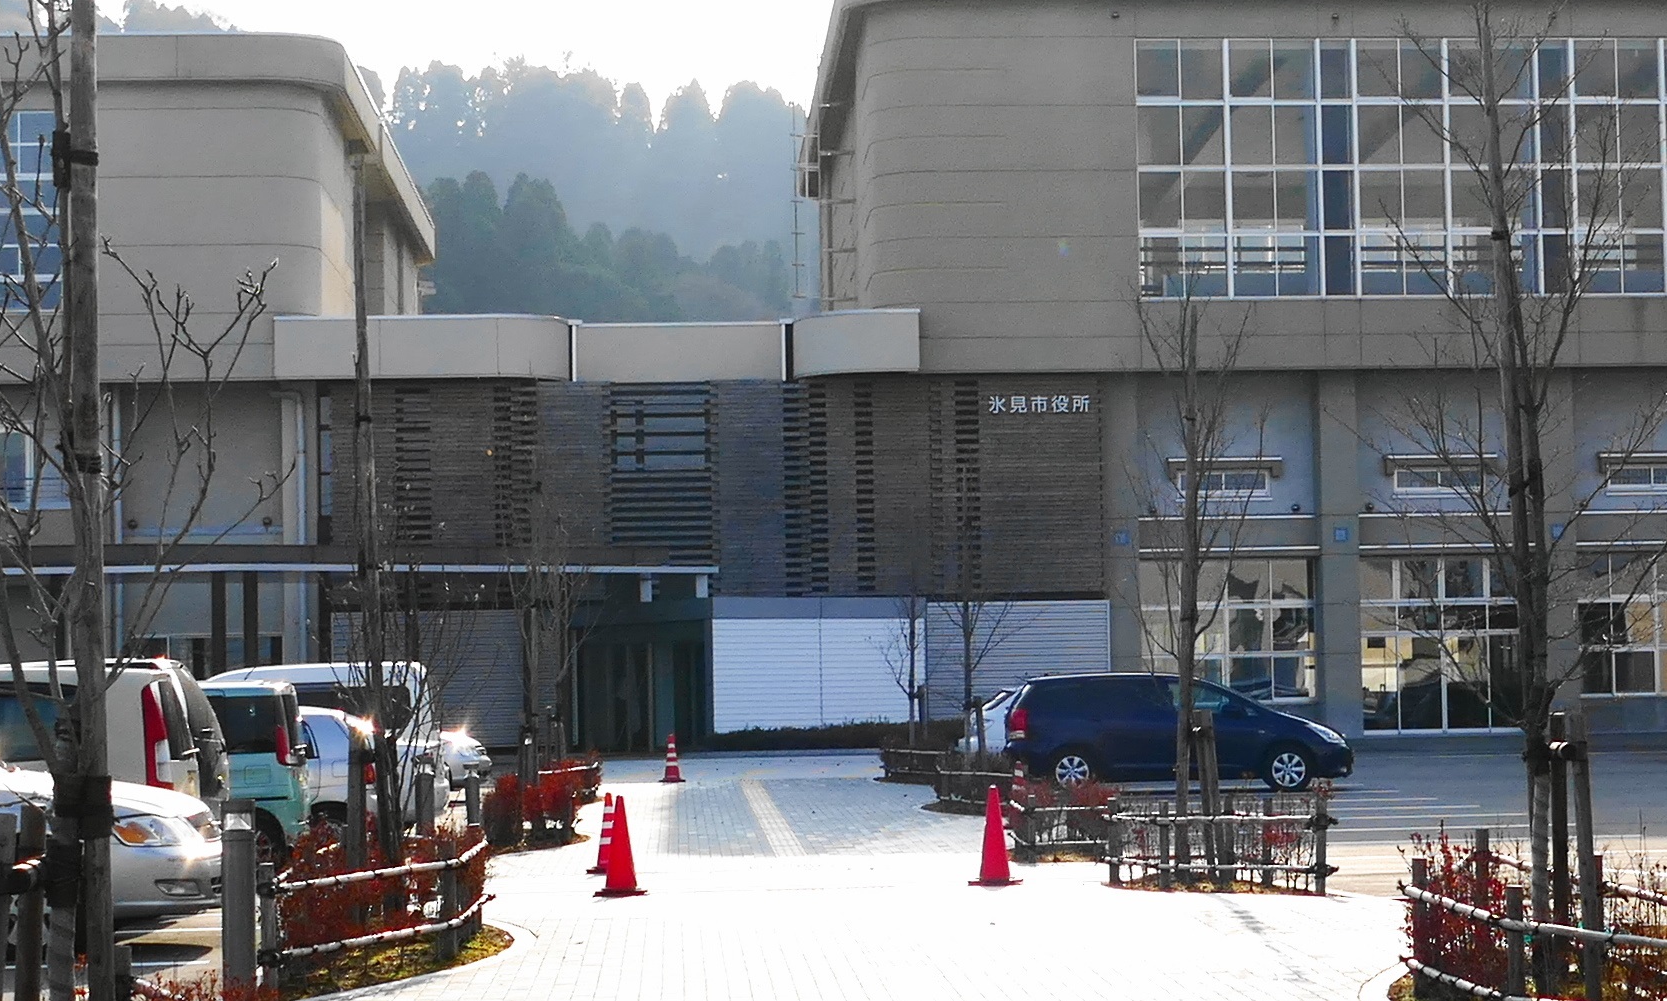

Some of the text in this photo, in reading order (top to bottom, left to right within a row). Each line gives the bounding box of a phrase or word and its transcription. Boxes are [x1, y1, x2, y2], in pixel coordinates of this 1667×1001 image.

[988, 394, 1090, 414] 氷見市役所
